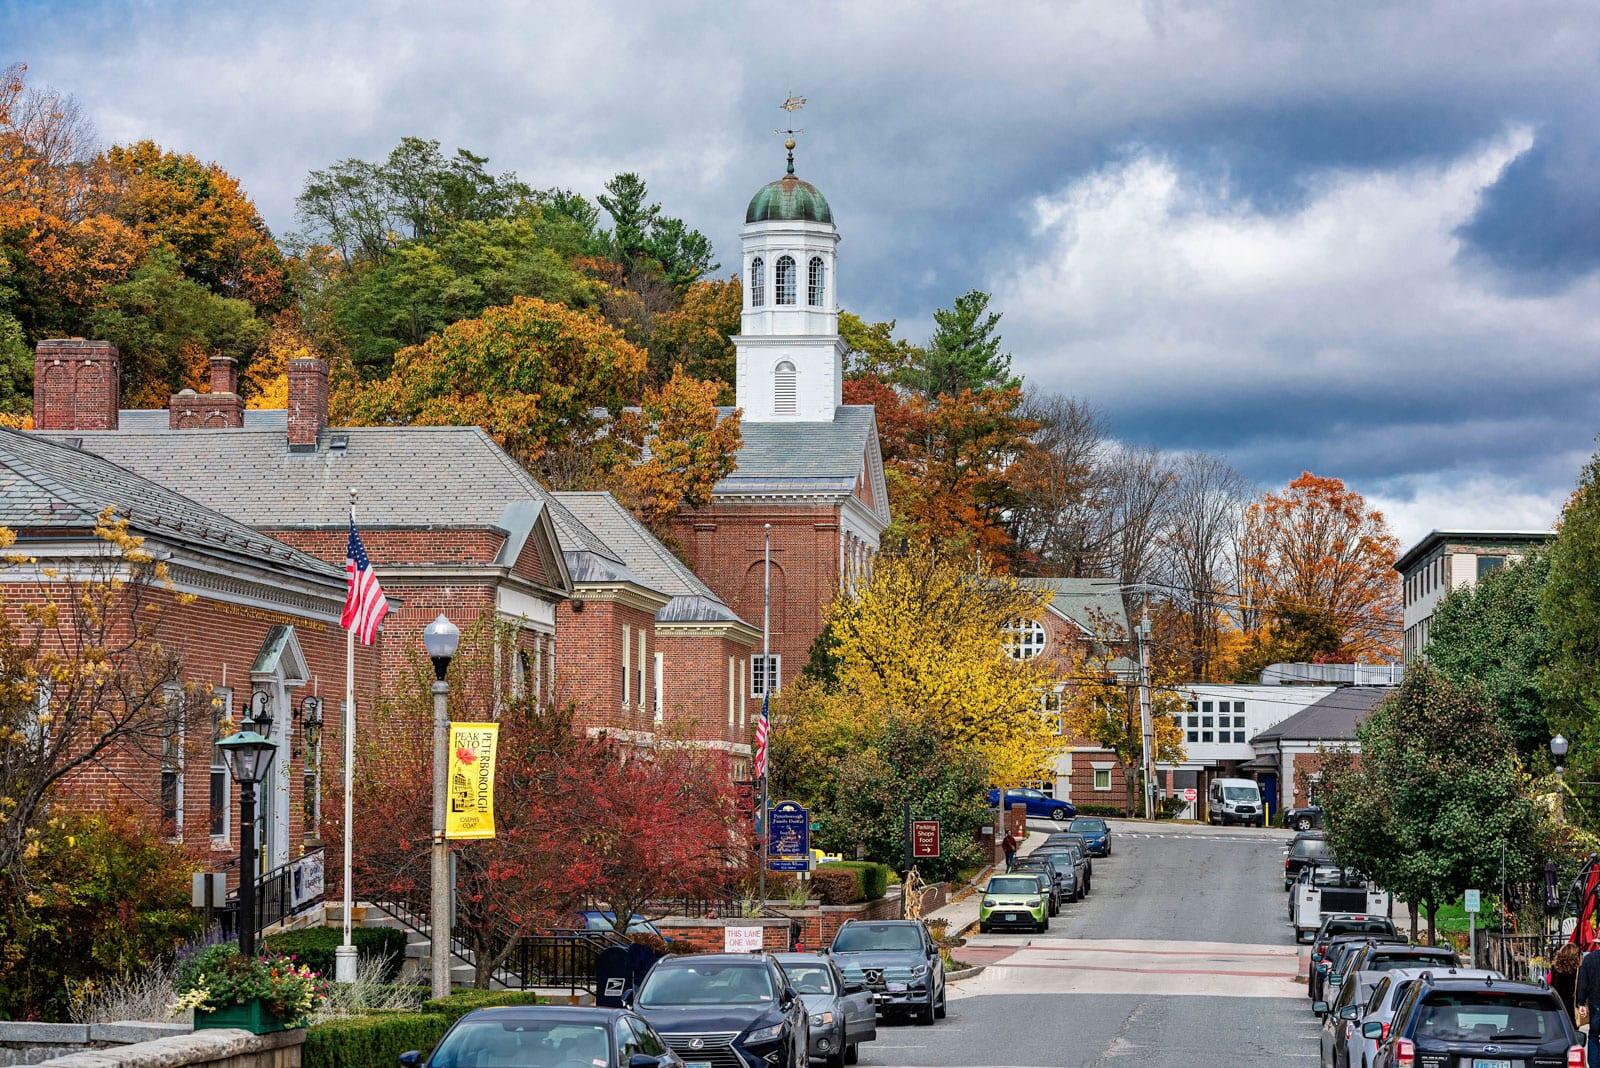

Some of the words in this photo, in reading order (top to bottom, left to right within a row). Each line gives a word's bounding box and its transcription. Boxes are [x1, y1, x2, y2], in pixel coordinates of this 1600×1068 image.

[455, 731, 480, 740] PEAK
[455, 740, 480, 749] INTO
[477, 732, 492, 813] PETERBOROUGH
[728, 930, 742, 938] THIS
[744, 930, 761, 938] LANE
[729, 939, 744, 947] ONE
